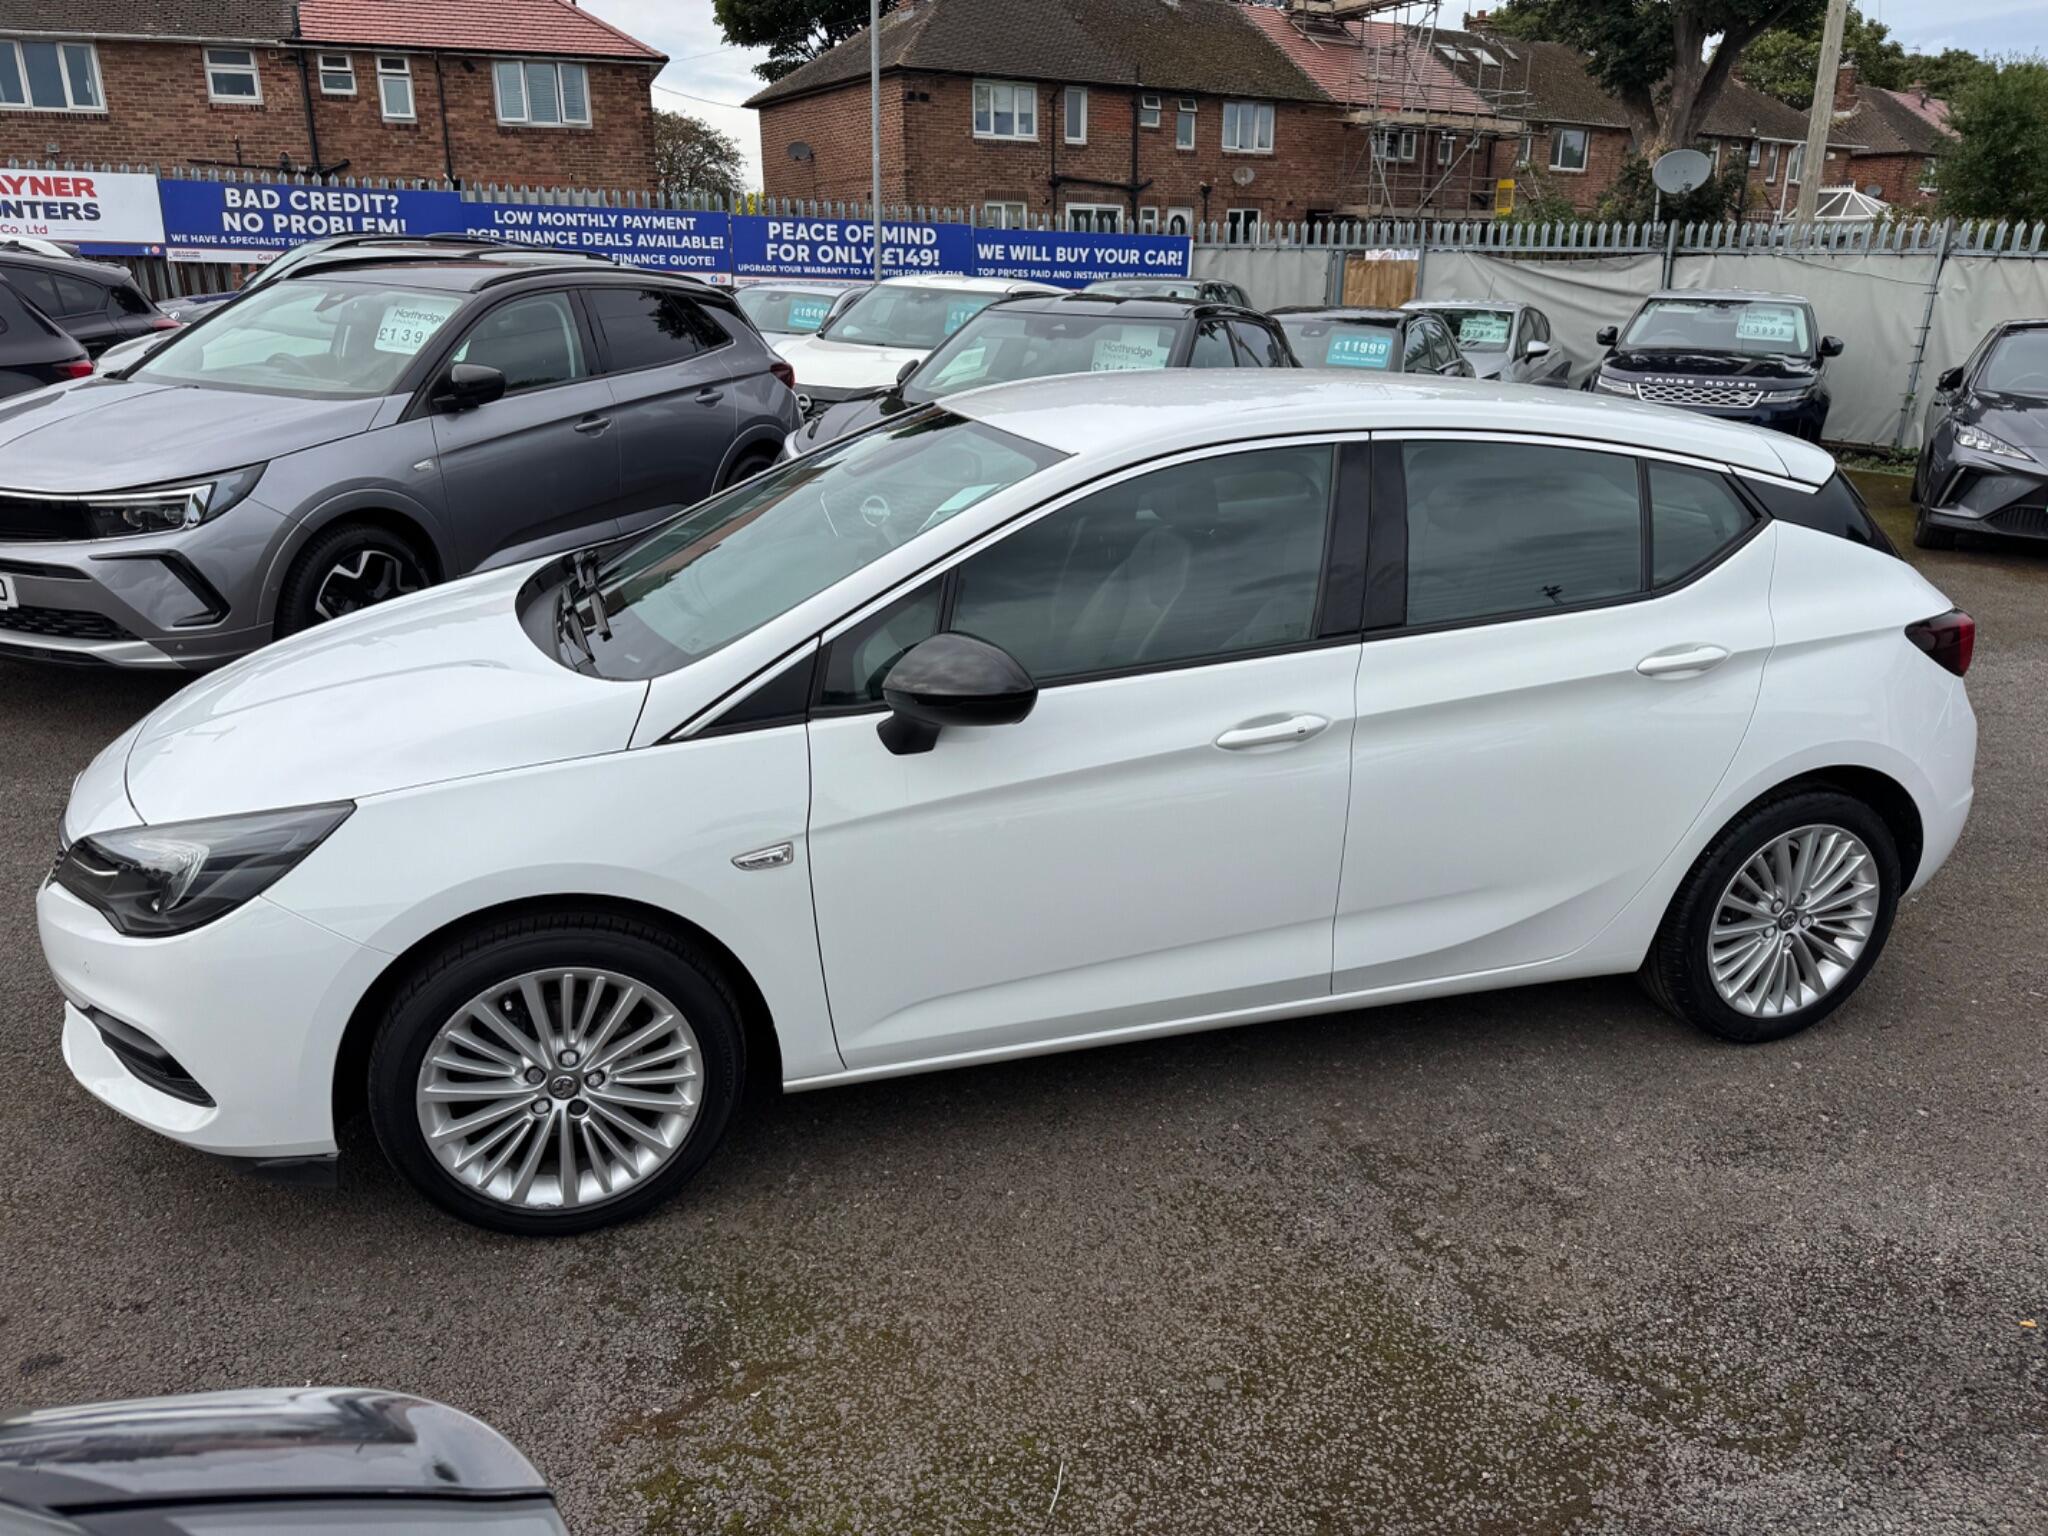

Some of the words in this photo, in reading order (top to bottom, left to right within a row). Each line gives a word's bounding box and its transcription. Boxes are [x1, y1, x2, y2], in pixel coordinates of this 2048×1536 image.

[225, 187, 280, 209] BAD
[289, 190, 399, 214] CREDIT?
[0, 200, 101, 221] NTERS
[222, 212, 264, 233] NO
[494, 210, 533, 225] LOW
[538, 212, 618, 228] MONTHLY
[623, 215, 697, 230] PAYMENT
[26, 225, 48, 235] Ltd
[505, 229, 578, 245] FINANCE
[582, 232, 633, 246] DEALS
[637, 234, 724, 249] AVAILABLE!
[768, 222, 838, 241] PEACE
[845, 225, 874, 243] OF
[881, 226, 937, 245] MIND
[171, 234, 188, 243] WE
[190, 235, 218, 243] HAVE
[230, 236, 286, 246] SPECIALIST
[612, 253, 666, 265] FINANCE
[670, 254, 715, 266] QUOTE!
[766, 244, 809, 262] FOR
[817, 245, 875, 264] ONLY
[881, 248, 940, 266] £149!
[977, 244, 1005, 260] WE
[1009, 245, 1051, 261] WILL
[1056, 246, 1090, 263] BUY
[1094, 248, 1140, 264] YOUR
[1144, 249, 1183, 266] CAR!
[738, 264, 776, 272] UPGRADE
[779, 265, 801, 273] YOUR
[803, 266, 847, 275] WARRANTY
[850, 267, 860, 275] TO
[977, 267, 995, 276] TOP
[998, 268, 1028, 278] PRICES
[1030, 269, 1051, 278] PAID
[1053, 270, 1072, 279] AND
[1074, 271, 1110, 279] INSTANT
[394, 308, 446, 324] Northridge
[1334, 341, 1386, 354] £11999
[1644, 377, 1695, 385] RANGE
[1704, 380, 1757, 388] ROVER
